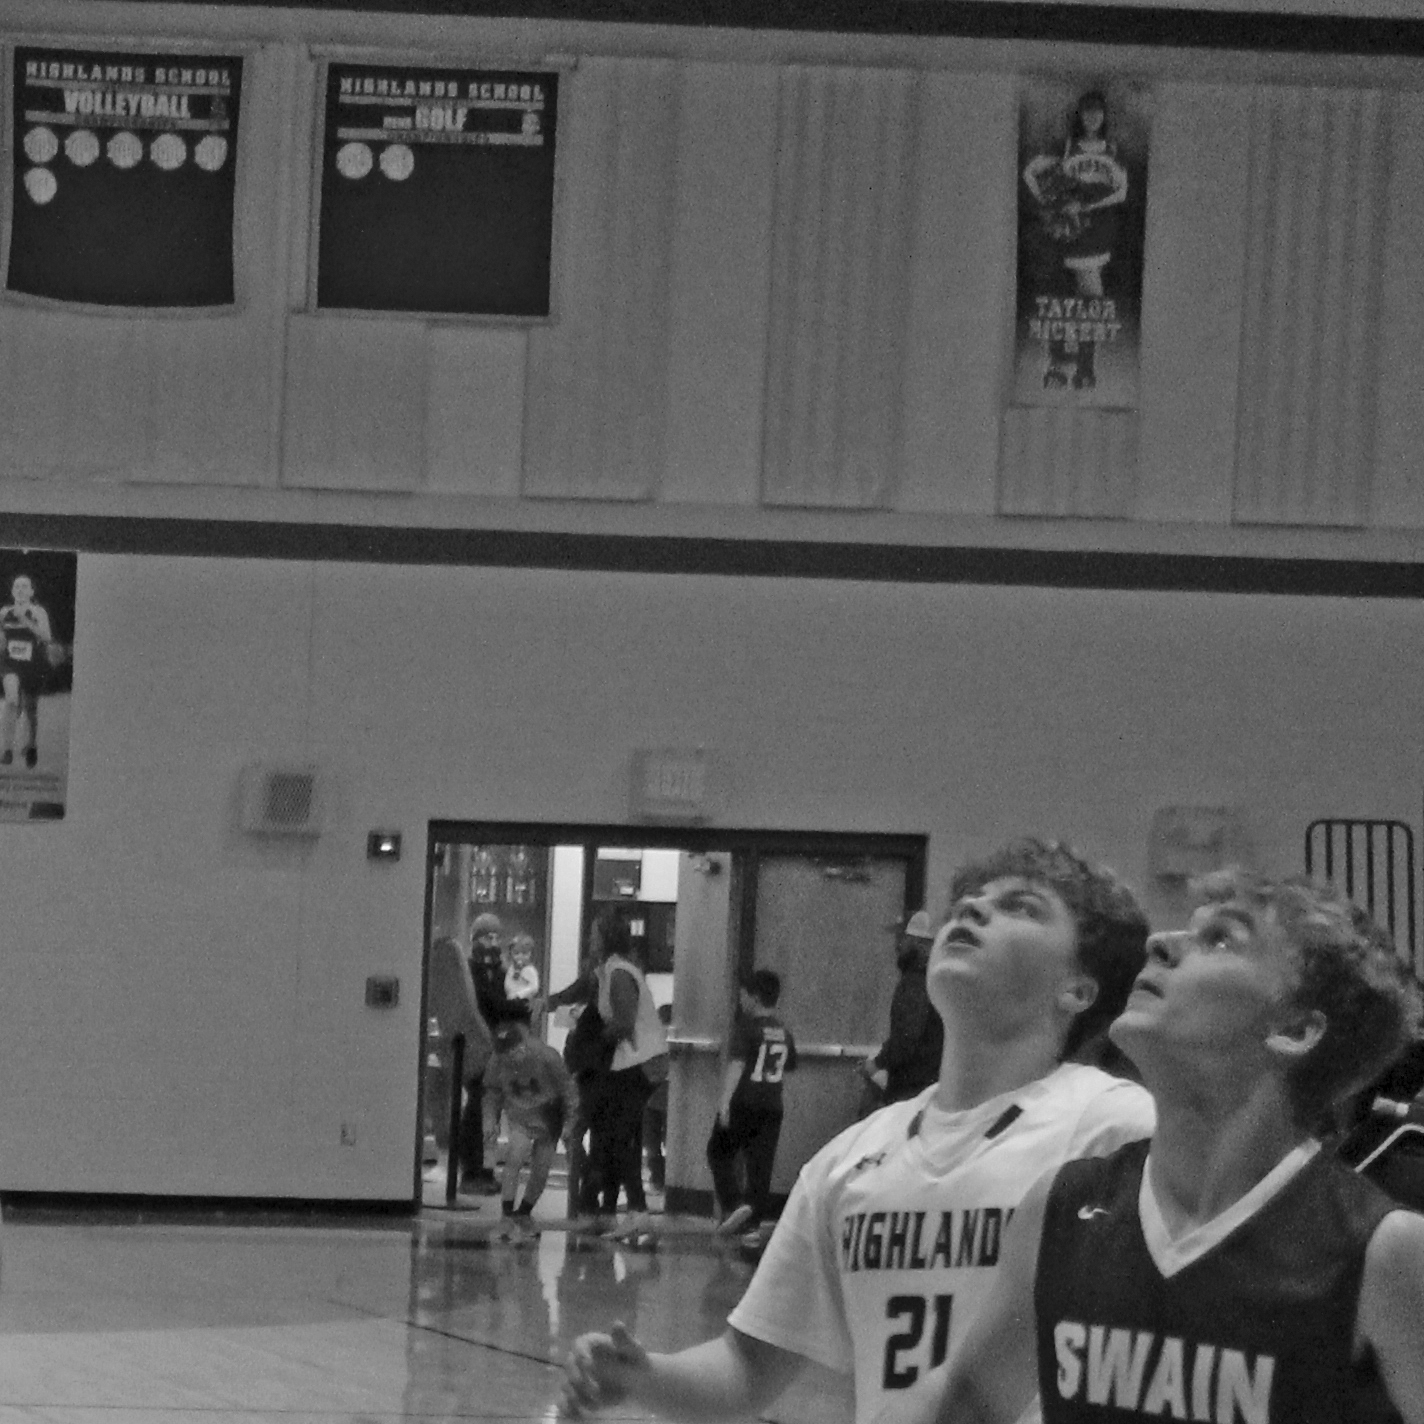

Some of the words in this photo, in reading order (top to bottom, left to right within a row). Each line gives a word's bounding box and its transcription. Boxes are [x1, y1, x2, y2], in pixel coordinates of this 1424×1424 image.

[25, 61, 145, 83] HIGHLANDS
[155, 67, 231, 86] SCHOOL
[340, 77, 458, 97] HIGHLANDS
[468, 82, 544, 101] SCHOOL
[63, 90, 191, 119] VOLLEYBALL
[1035, 295, 1116, 319] TAYLOR
[749, 1042, 789, 1083] 13
[842, 1207, 1015, 1271] HIGHLAND
[883, 1294, 954, 1389] 21
